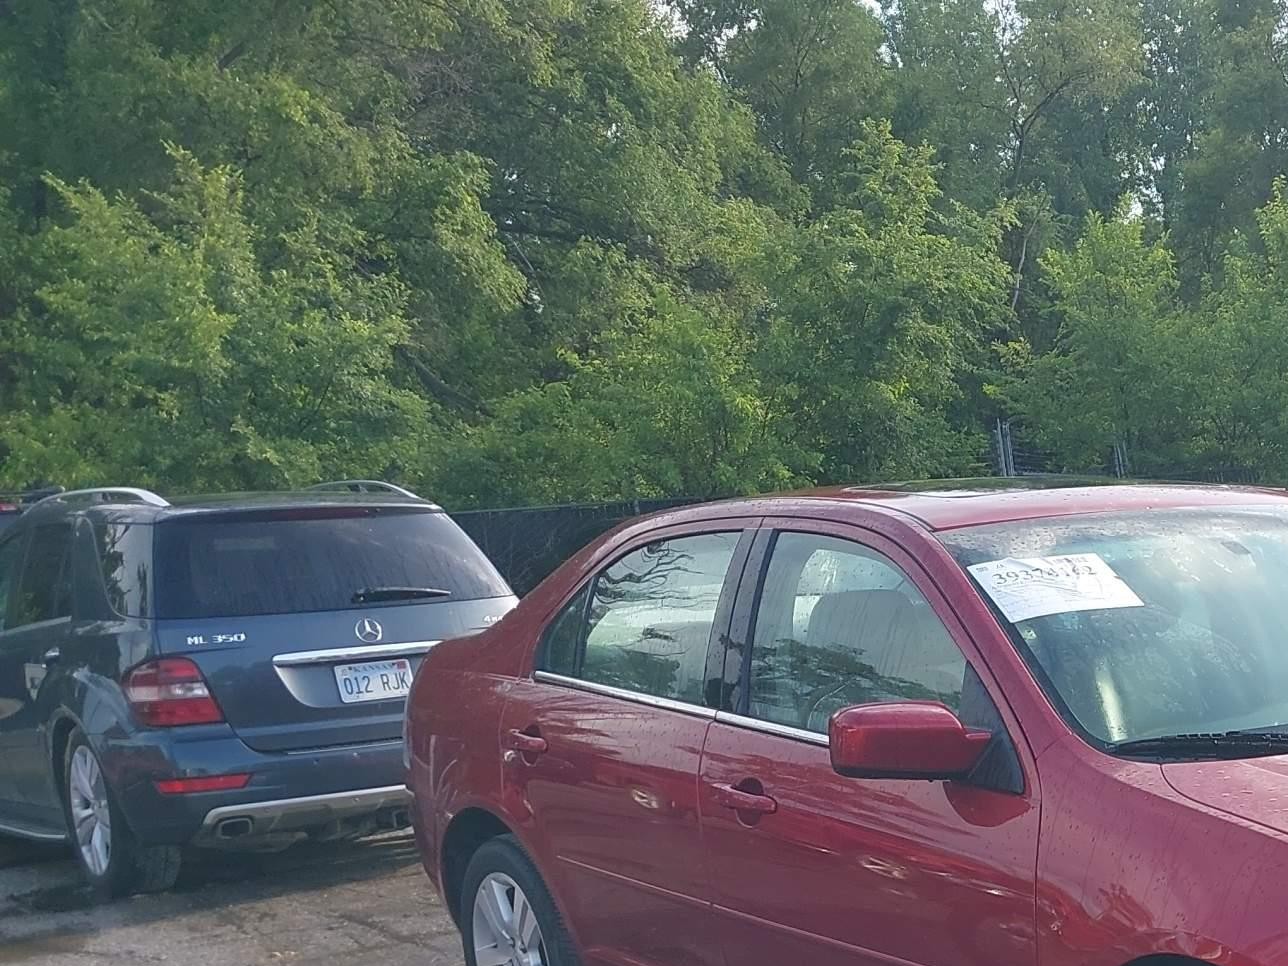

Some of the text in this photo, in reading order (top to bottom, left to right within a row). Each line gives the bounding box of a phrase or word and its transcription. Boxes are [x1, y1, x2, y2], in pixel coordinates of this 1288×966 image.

[187, 633, 246, 645] ML 350
[343, 672, 410, 695] 012 RJK
